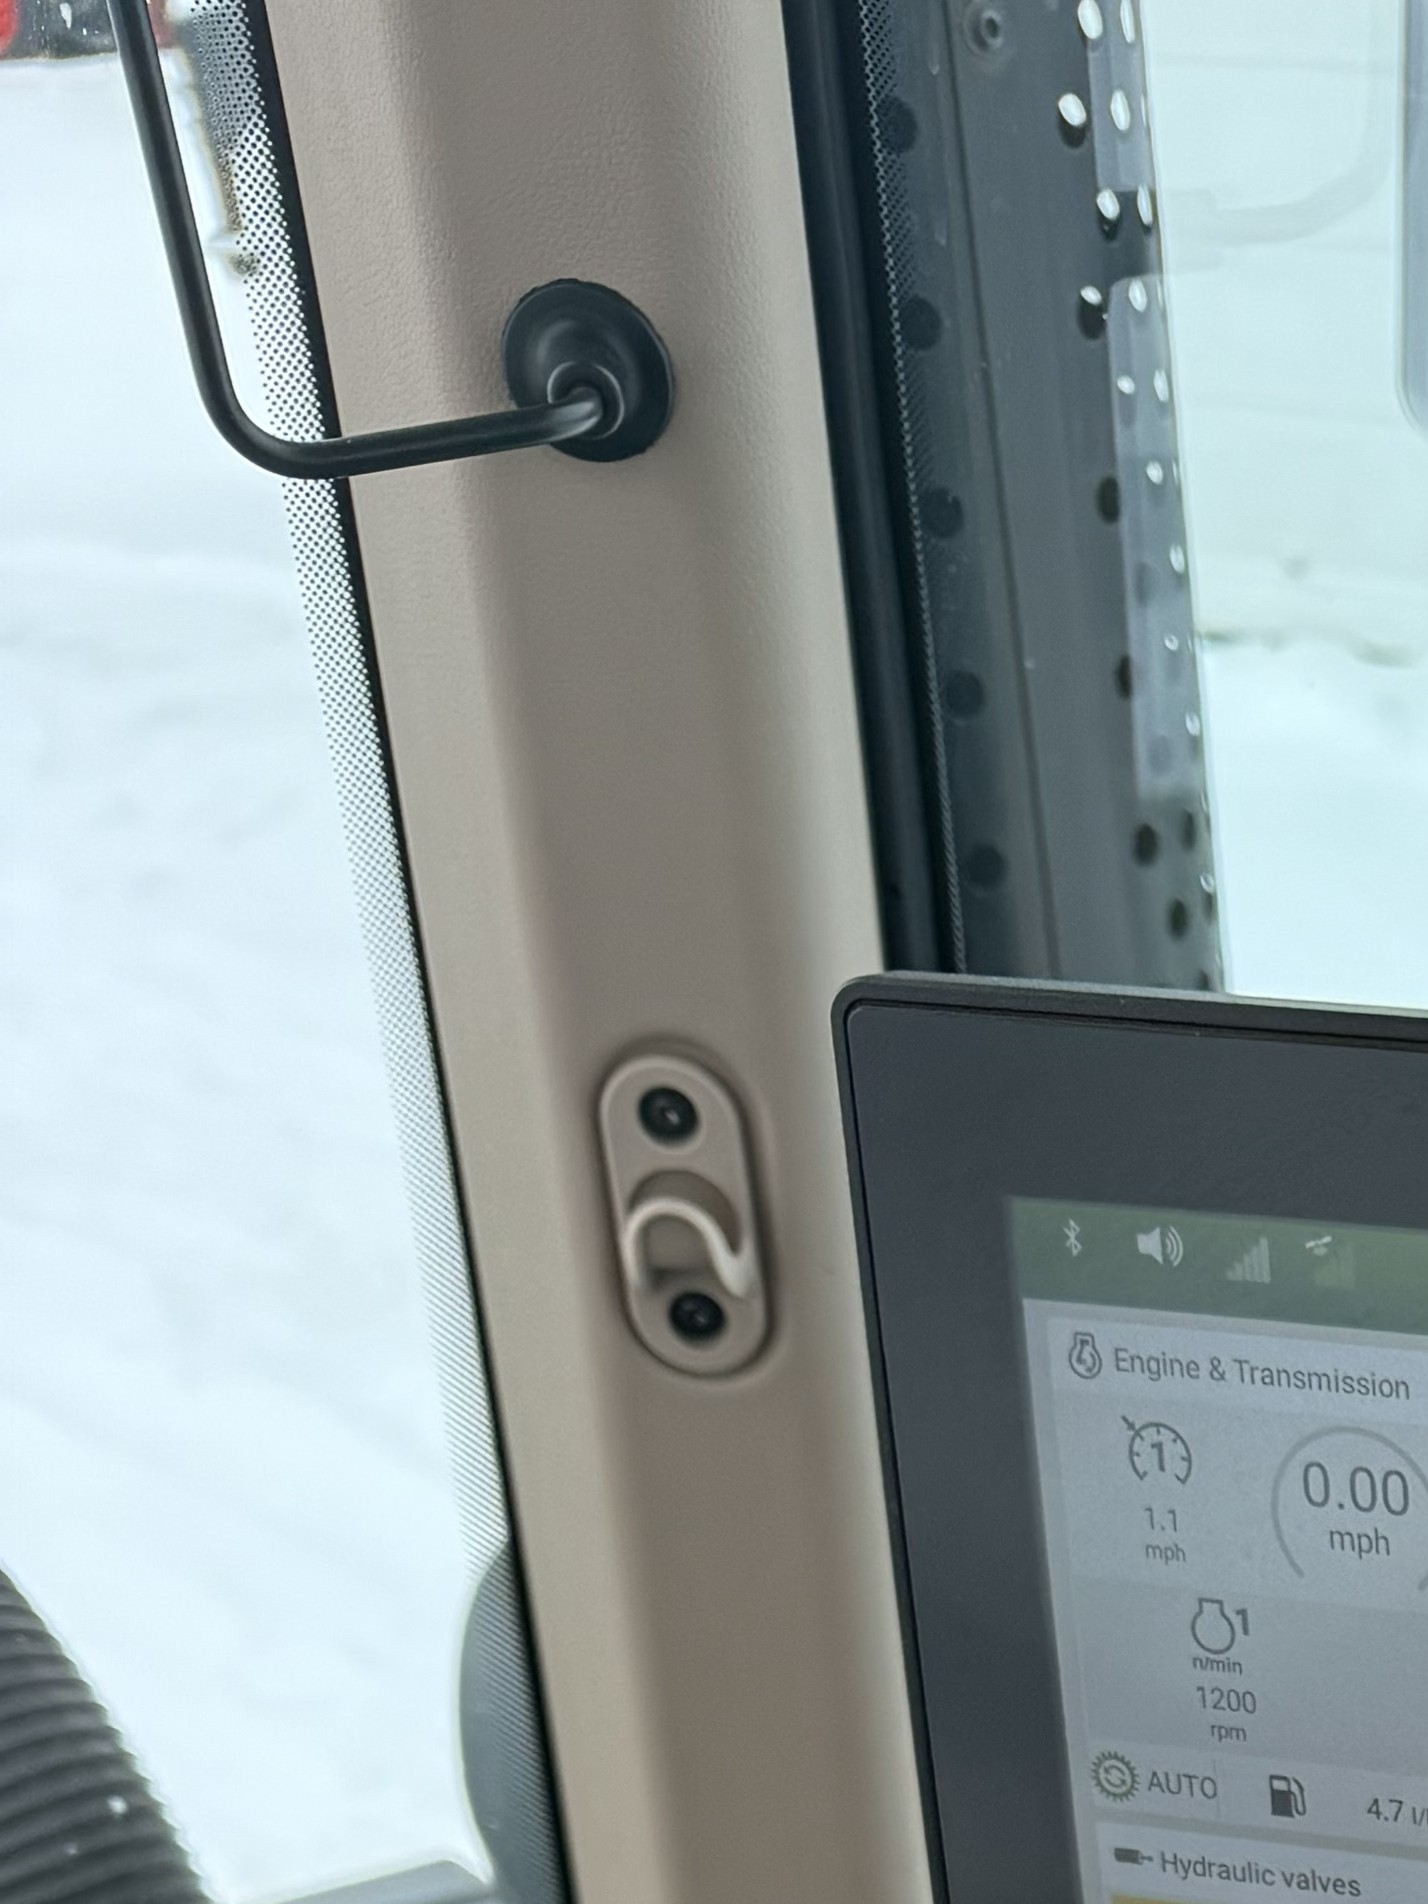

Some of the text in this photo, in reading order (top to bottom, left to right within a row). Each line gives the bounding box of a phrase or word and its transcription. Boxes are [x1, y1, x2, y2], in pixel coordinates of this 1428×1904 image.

[1114, 1348, 1410, 1400] Engine & Transmission
[1302, 1462, 1410, 1516] 0.00
[1144, 1507, 1178, 1532] 1.1
[1145, 1544, 1186, 1565] mph
[1329, 1528, 1390, 1559] mph
[1192, 1656, 1242, 1676] n/min
[1196, 1686, 1257, 1714] 1200
[1211, 1724, 1247, 1742] rpm
[1148, 1771, 1218, 1799] AUTO
[1367, 1798, 1404, 1823] 4.7
[1160, 1851, 1362, 1897] Hydraulic valves
